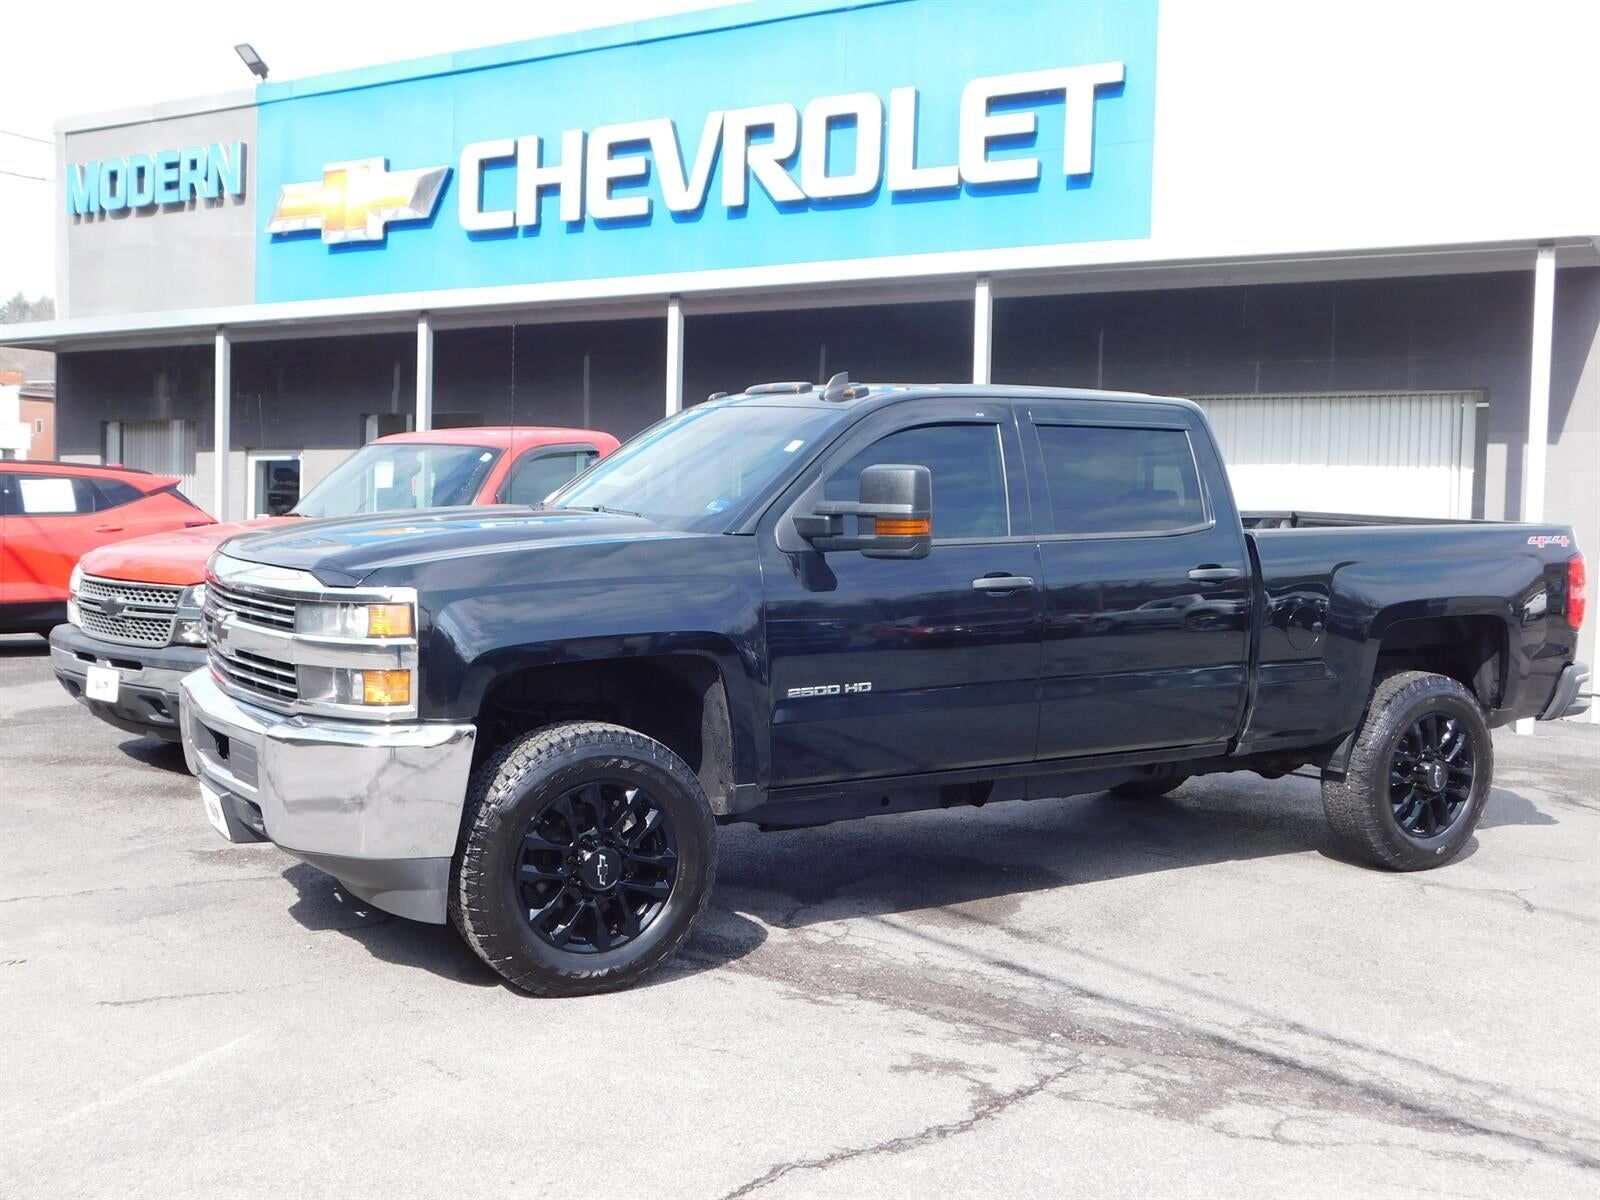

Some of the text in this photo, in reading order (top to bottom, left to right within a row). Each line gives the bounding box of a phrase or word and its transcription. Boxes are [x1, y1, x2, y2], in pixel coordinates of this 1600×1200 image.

[66, 140, 243, 216] MODERN
[458, 61, 1125, 232] CHEVROLET
[787, 681, 872, 699] 2500 HD
